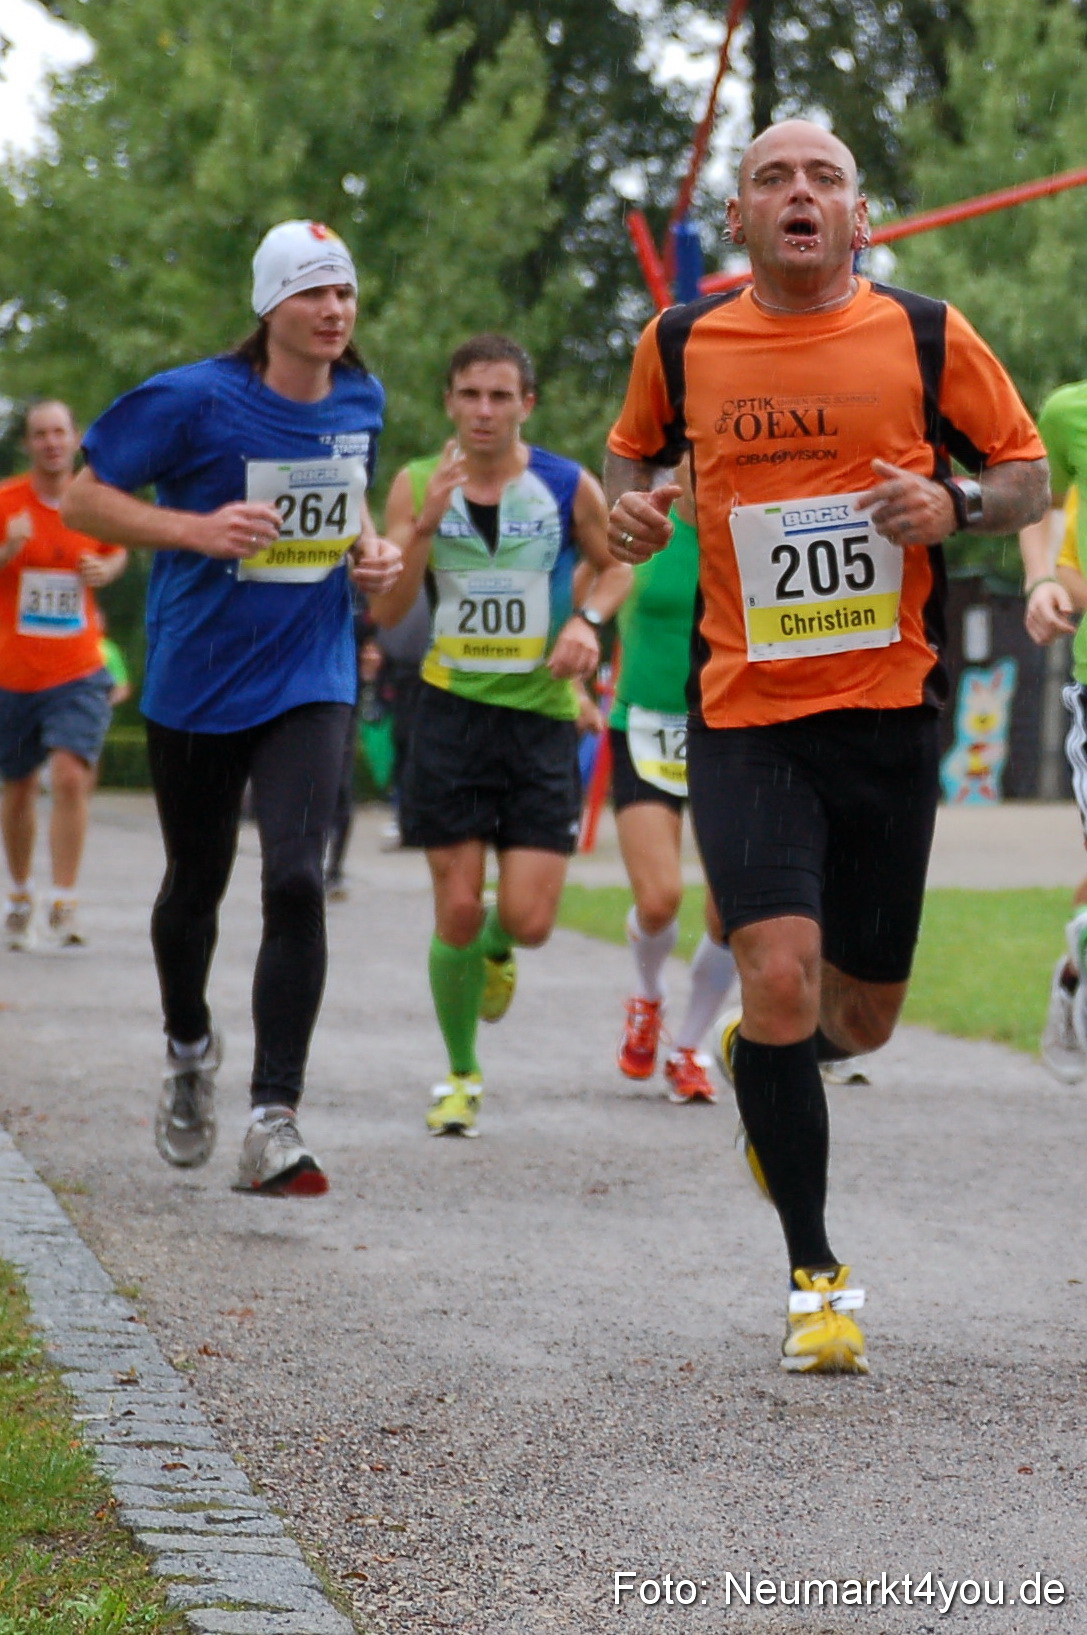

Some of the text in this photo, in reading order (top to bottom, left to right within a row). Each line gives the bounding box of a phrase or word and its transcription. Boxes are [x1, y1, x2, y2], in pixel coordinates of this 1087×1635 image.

[733, 408, 838, 442] OEXL
[275, 492, 349, 537] 264
[783, 506, 848, 527] BOCK
[771, 535, 875, 600] 205
[458, 598, 526, 634] 200
[780, 607, 875, 636] Christian
